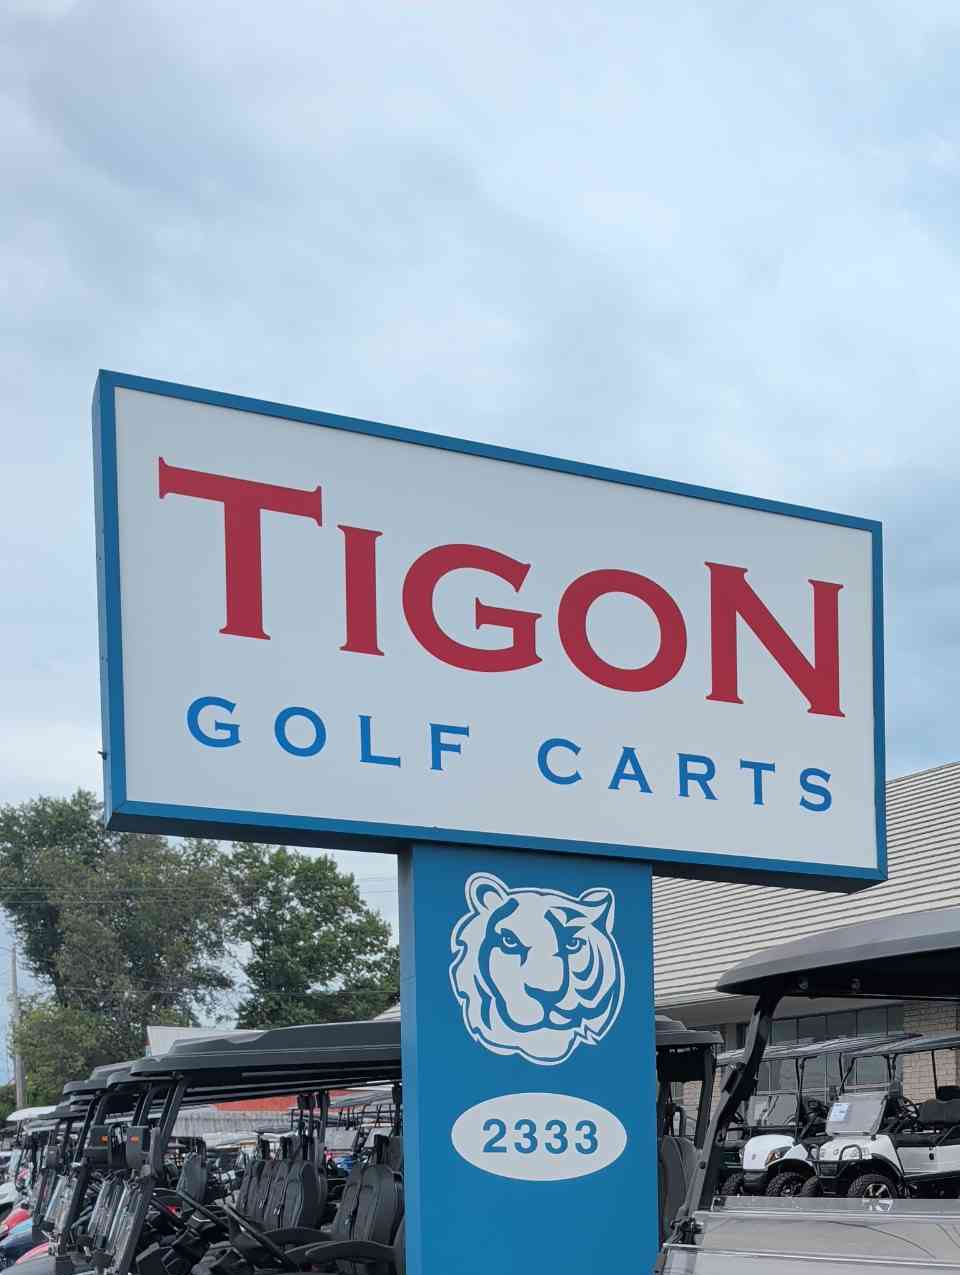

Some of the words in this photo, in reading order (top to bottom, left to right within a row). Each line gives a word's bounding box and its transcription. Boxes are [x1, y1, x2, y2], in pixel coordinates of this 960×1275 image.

[158, 456, 846, 718] TIGON
[186, 695, 470, 771] GOLF
[537, 737, 833, 812] CARTS
[482, 1118, 598, 1154] 2333
